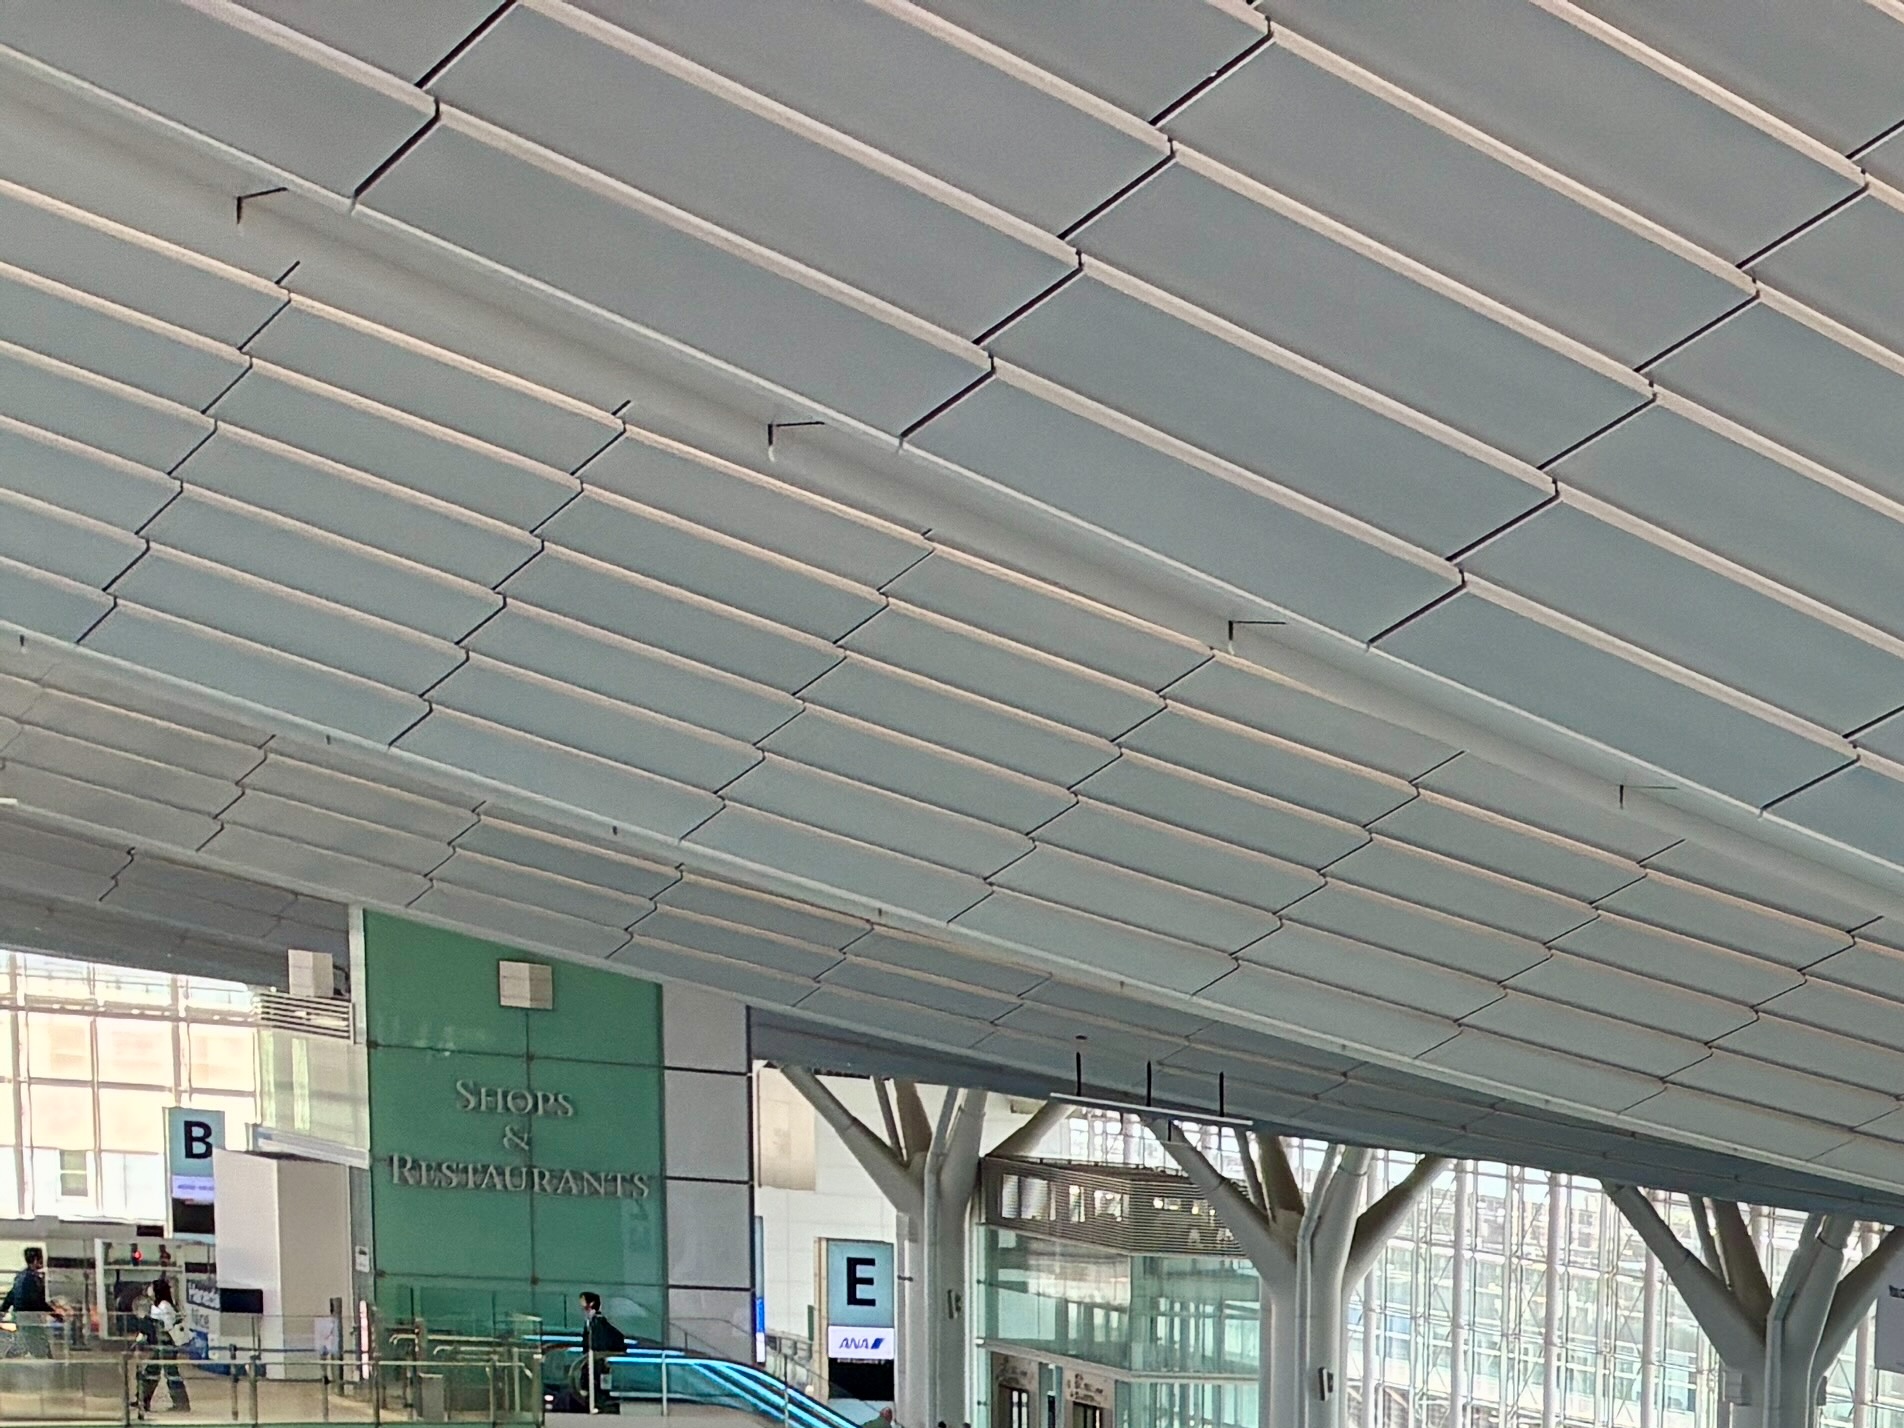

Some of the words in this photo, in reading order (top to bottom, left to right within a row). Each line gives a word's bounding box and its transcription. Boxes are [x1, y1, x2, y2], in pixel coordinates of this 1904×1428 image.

[456, 1079, 573, 1117] SHOPS
[183, 1120, 213, 1159] B
[503, 1124, 529, 1150] &
[391, 1152, 650, 1198] RESTAURANTS
[846, 1256, 876, 1307] E
[839, 1337, 869, 1350] ANA
